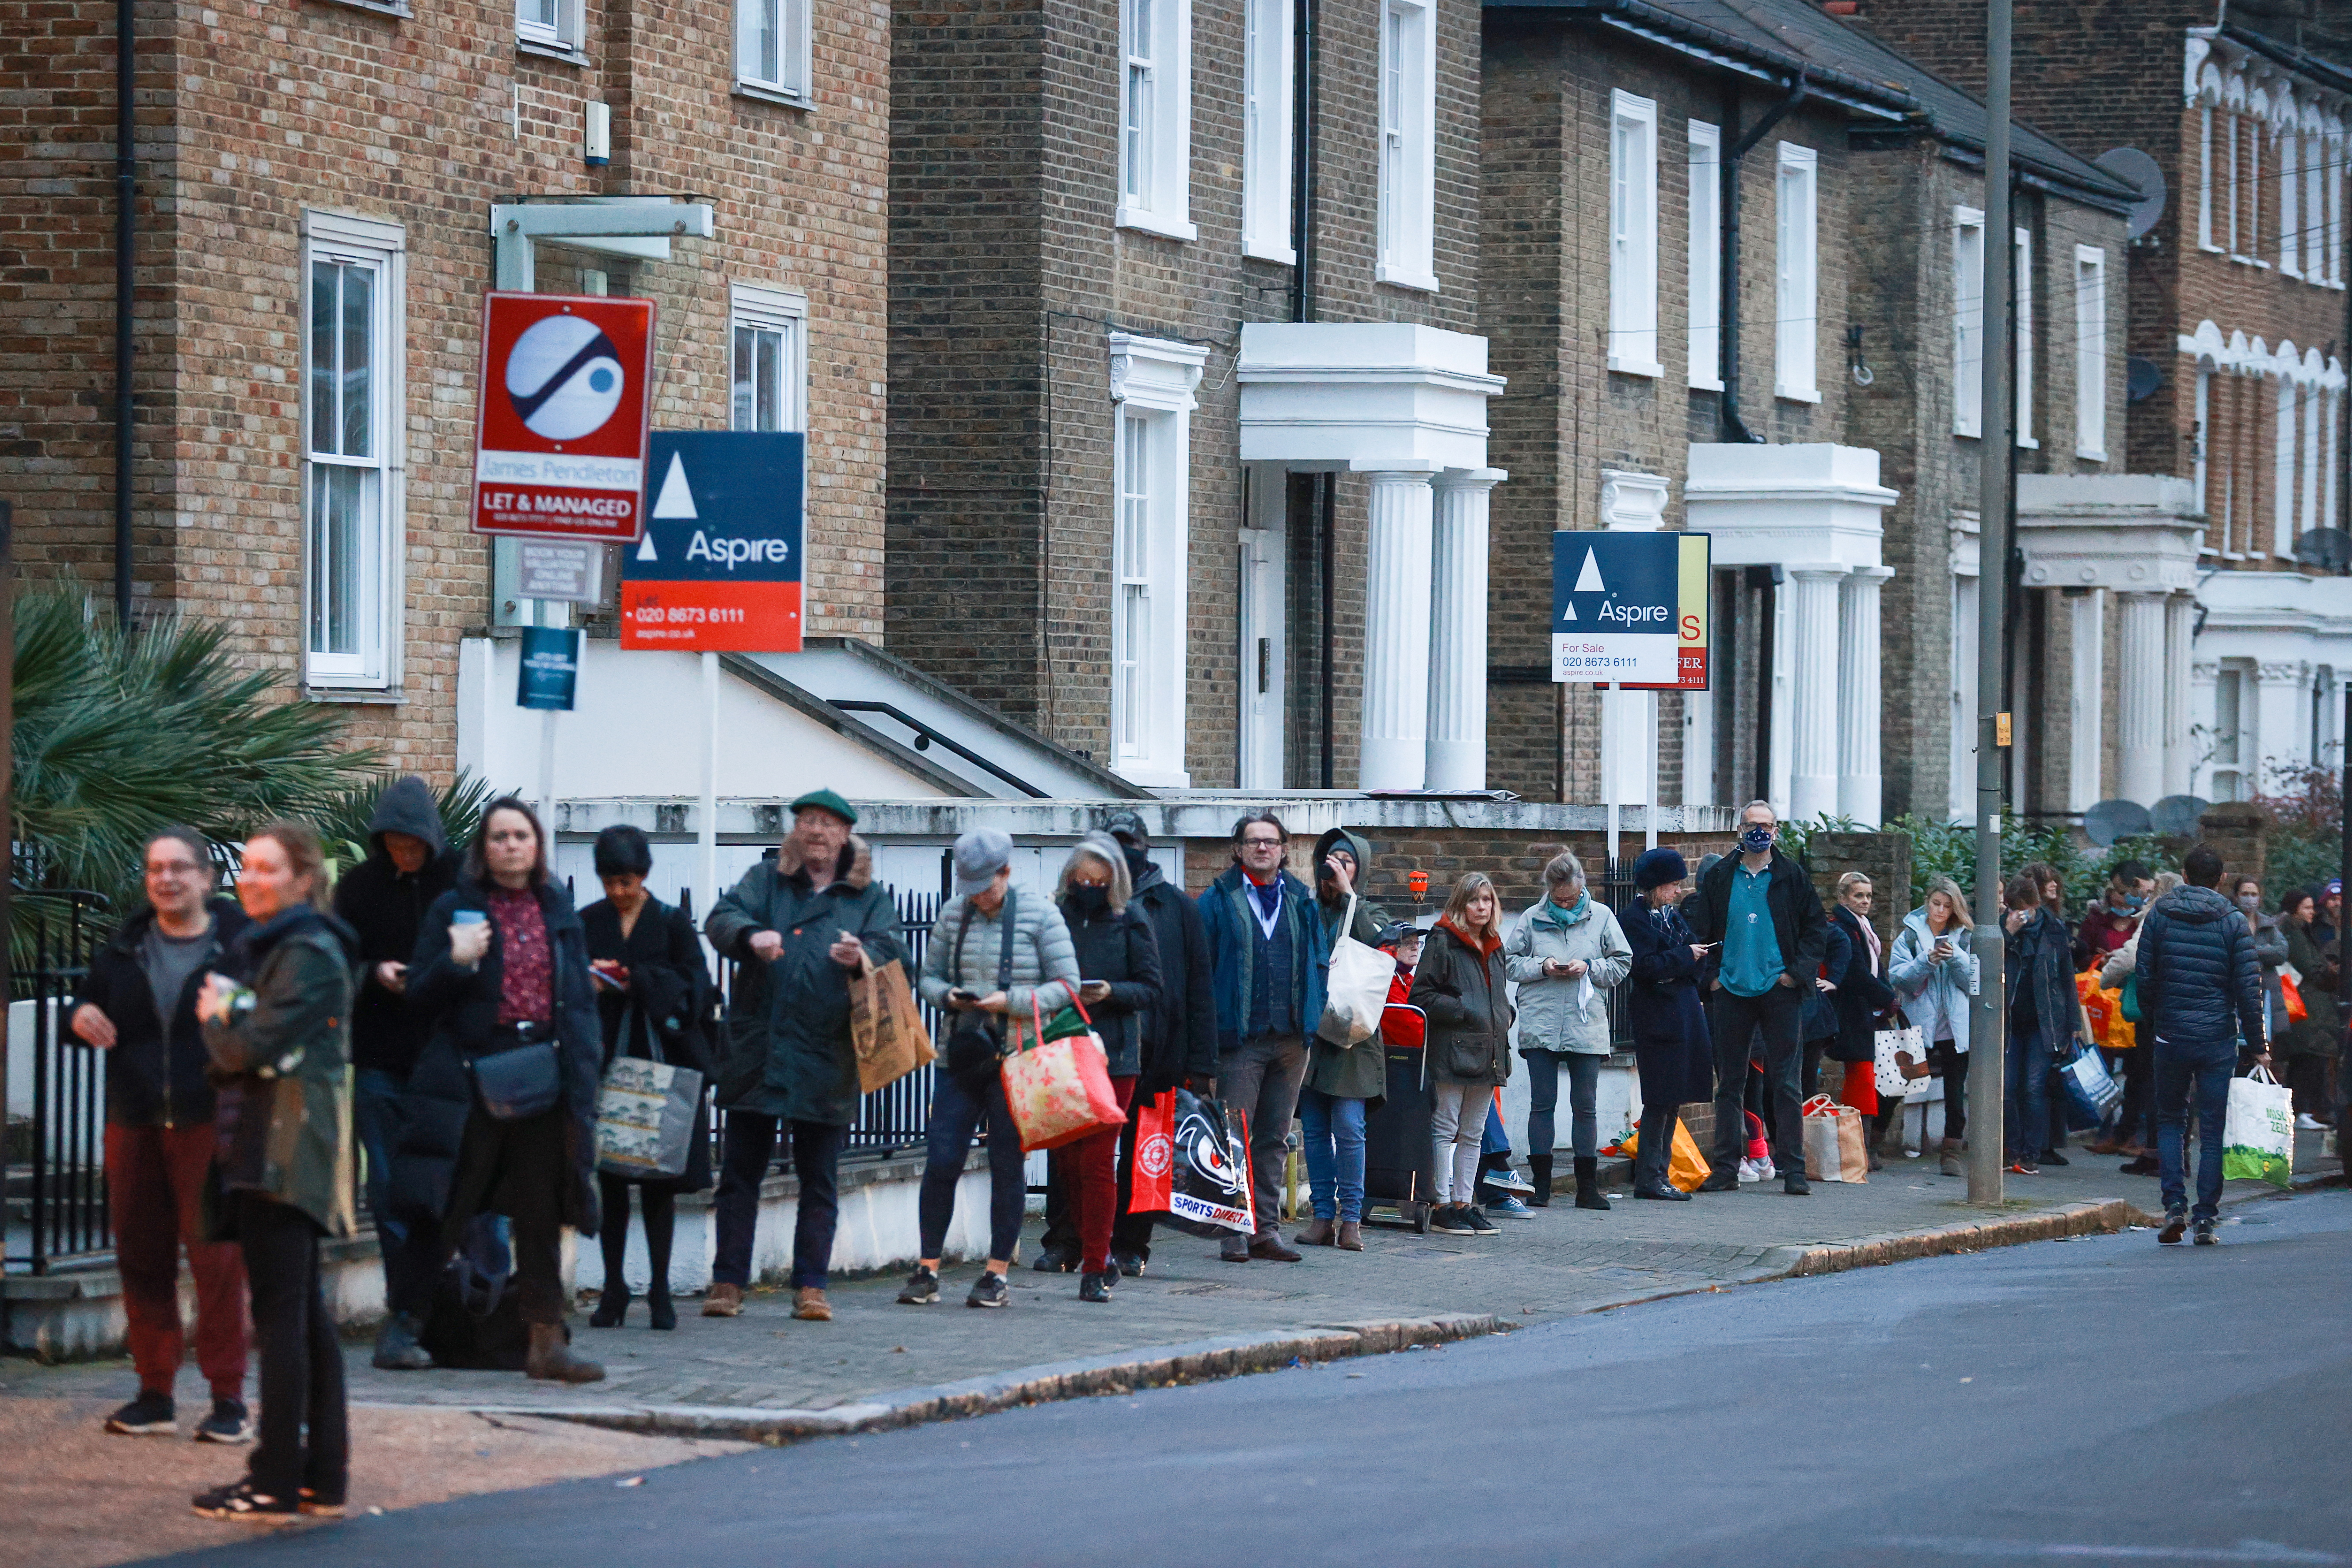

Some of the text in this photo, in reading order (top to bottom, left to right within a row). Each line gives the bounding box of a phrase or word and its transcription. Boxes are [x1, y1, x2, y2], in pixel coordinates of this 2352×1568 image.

[481, 456, 638, 483] James Pendleton
[483, 492, 515, 510] LET
[517, 494, 532, 511] &
[535, 495, 632, 518] MANAGED
[686, 530, 788, 571] Aspire
[636, 608, 744, 623] 020 8673 6111
[1598, 600, 1668, 627] Aspire
[1563, 643, 1604, 653] For Sale
[1563, 657, 1637, 666] 020 8673 6111
[2266, 1107, 2287, 1121] MISL
